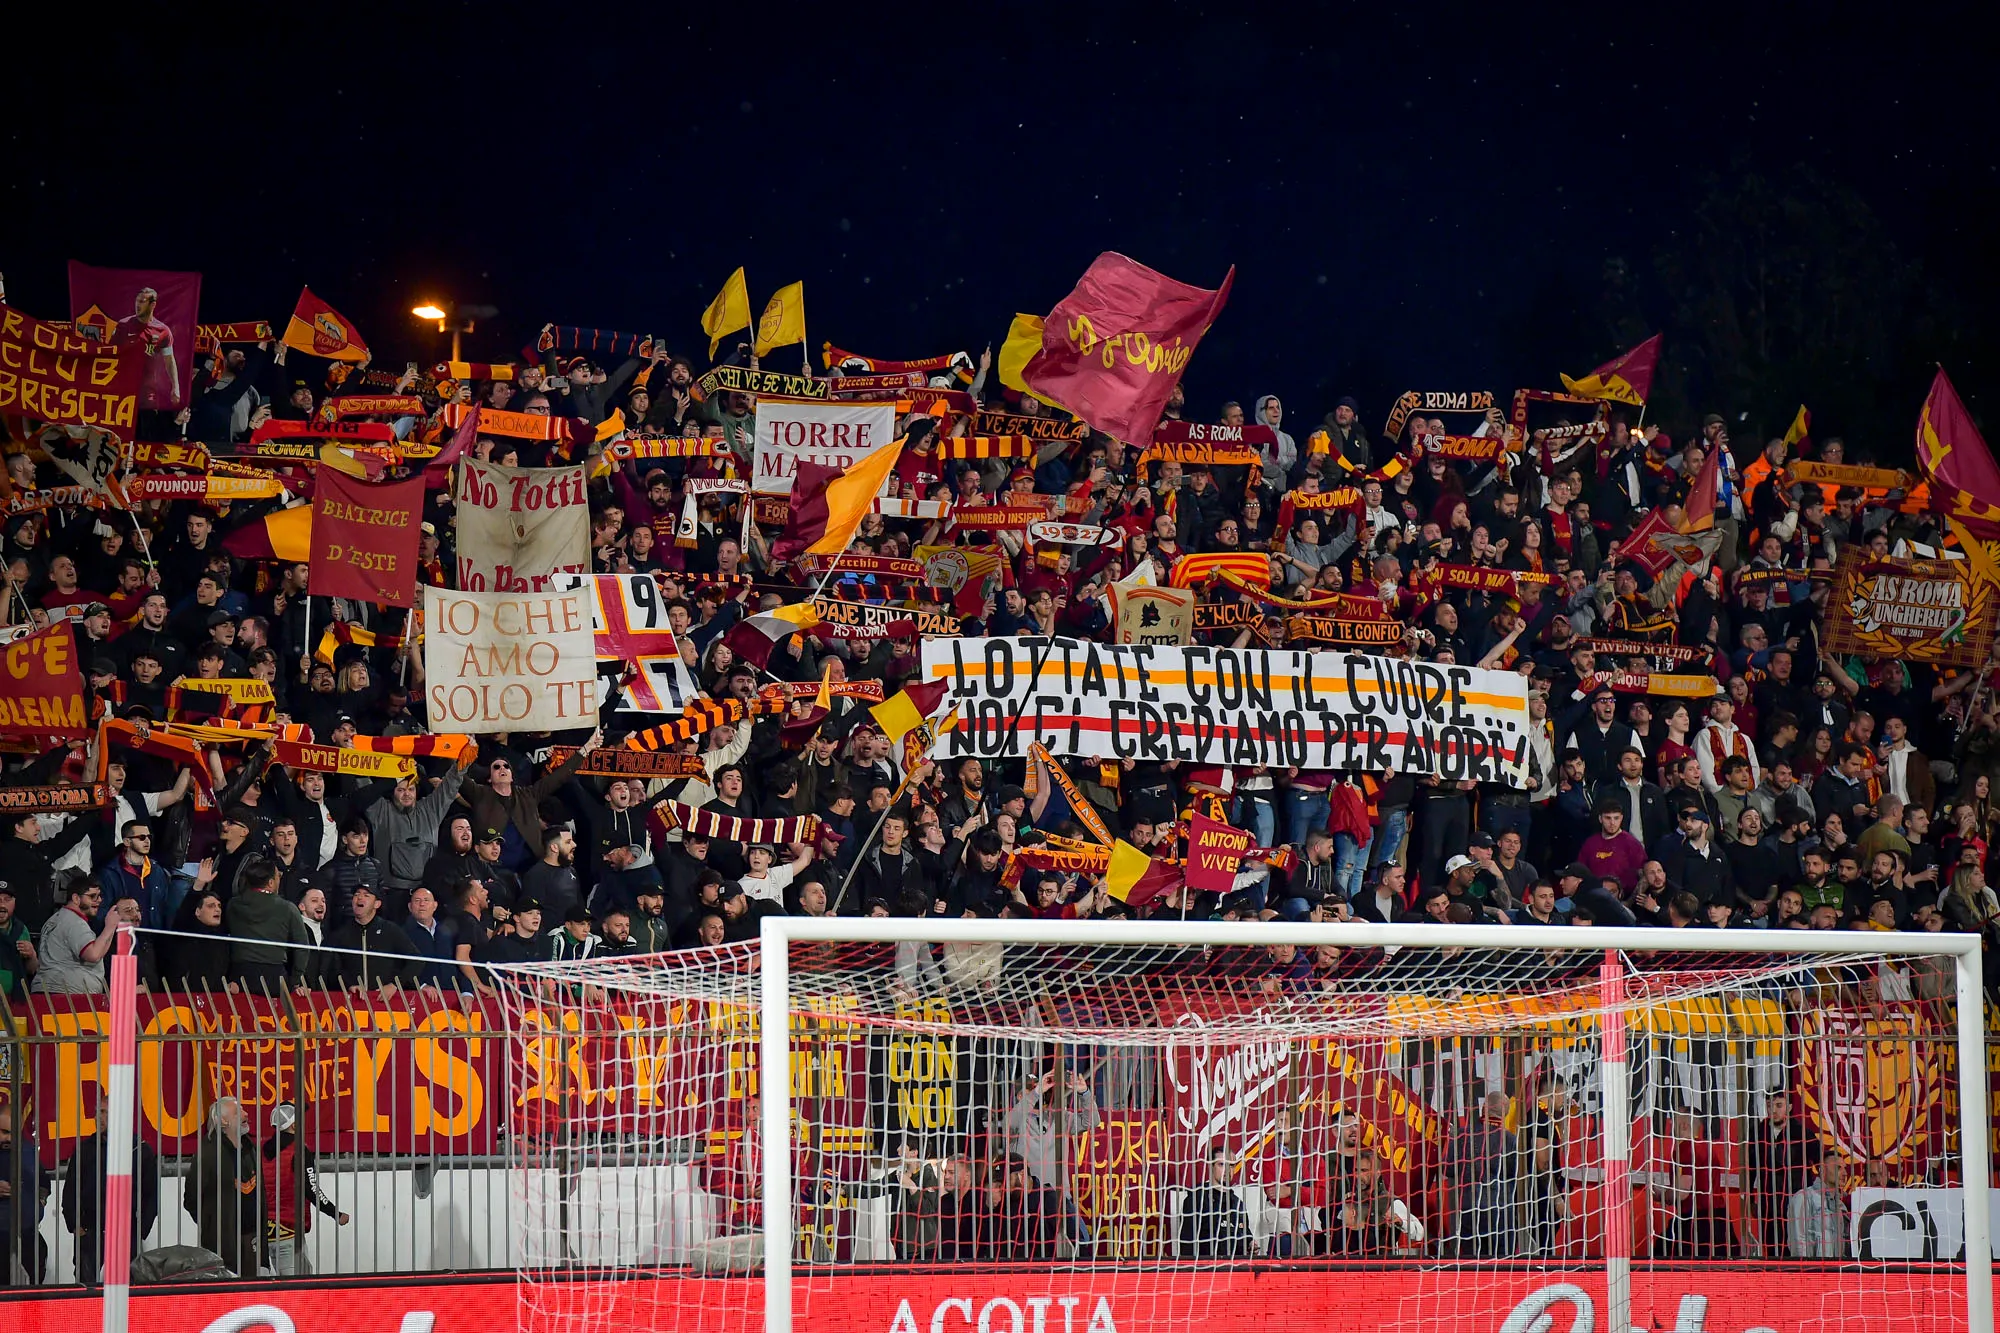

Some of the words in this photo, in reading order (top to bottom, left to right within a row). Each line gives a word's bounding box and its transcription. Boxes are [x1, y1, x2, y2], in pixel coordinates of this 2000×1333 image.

[1, 341, 120, 387] CLUB
[718, 368, 741, 388] CHI
[745, 371, 761, 391] VE
[763, 374, 781, 393] SE
[0, 371, 137, 428] BRESCIA
[1425, 391, 1468, 408] ROMA
[491, 415, 544, 434] ROMA
[769, 421, 873, 448] TORRE
[146, 479, 206, 493] OVUNQUE
[209, 480, 224, 492] TU
[461, 464, 498, 510] No
[509, 470, 586, 512] Totti
[322, 499, 410, 527] BEATRICE
[1007, 512, 1047, 524] INSIEME
[1448, 568, 1480, 585] SOLA
[1870, 574, 1901, 602] AS
[1902, 576, 1963, 608] ROMA
[437, 598, 480, 636] IO
[493, 597, 582, 636] CHE
[917, 612, 962, 634] DAJE
[1873, 603, 1949, 629] UNGHERIA
[1338, 622, 1352, 639] TE
[1354, 622, 1400, 640] GONFIO
[457, 641, 560, 678] AMO
[952, 637, 1160, 702] LOTTATE
[1182, 647, 1273, 712] CON
[1594, 671, 1648, 688] OVNQUE
[431, 684, 533, 723] SOLO
[546, 679, 597, 719] TE
[949, 698, 1019, 756] NOI
[1035, 695, 1081, 754] CI
[1319, 711, 1392, 770] PER
[616, 752, 682, 774] PROBLEMA
[51, 788, 89, 804] ROMA
[1201, 853, 1241, 873] VIVE!
[198, 1005, 352, 1054] MASSIMO
[889, 1041, 958, 1082] CON
[207, 1057, 352, 1106] PRESENTE
[897, 1087, 955, 1129] NOI
